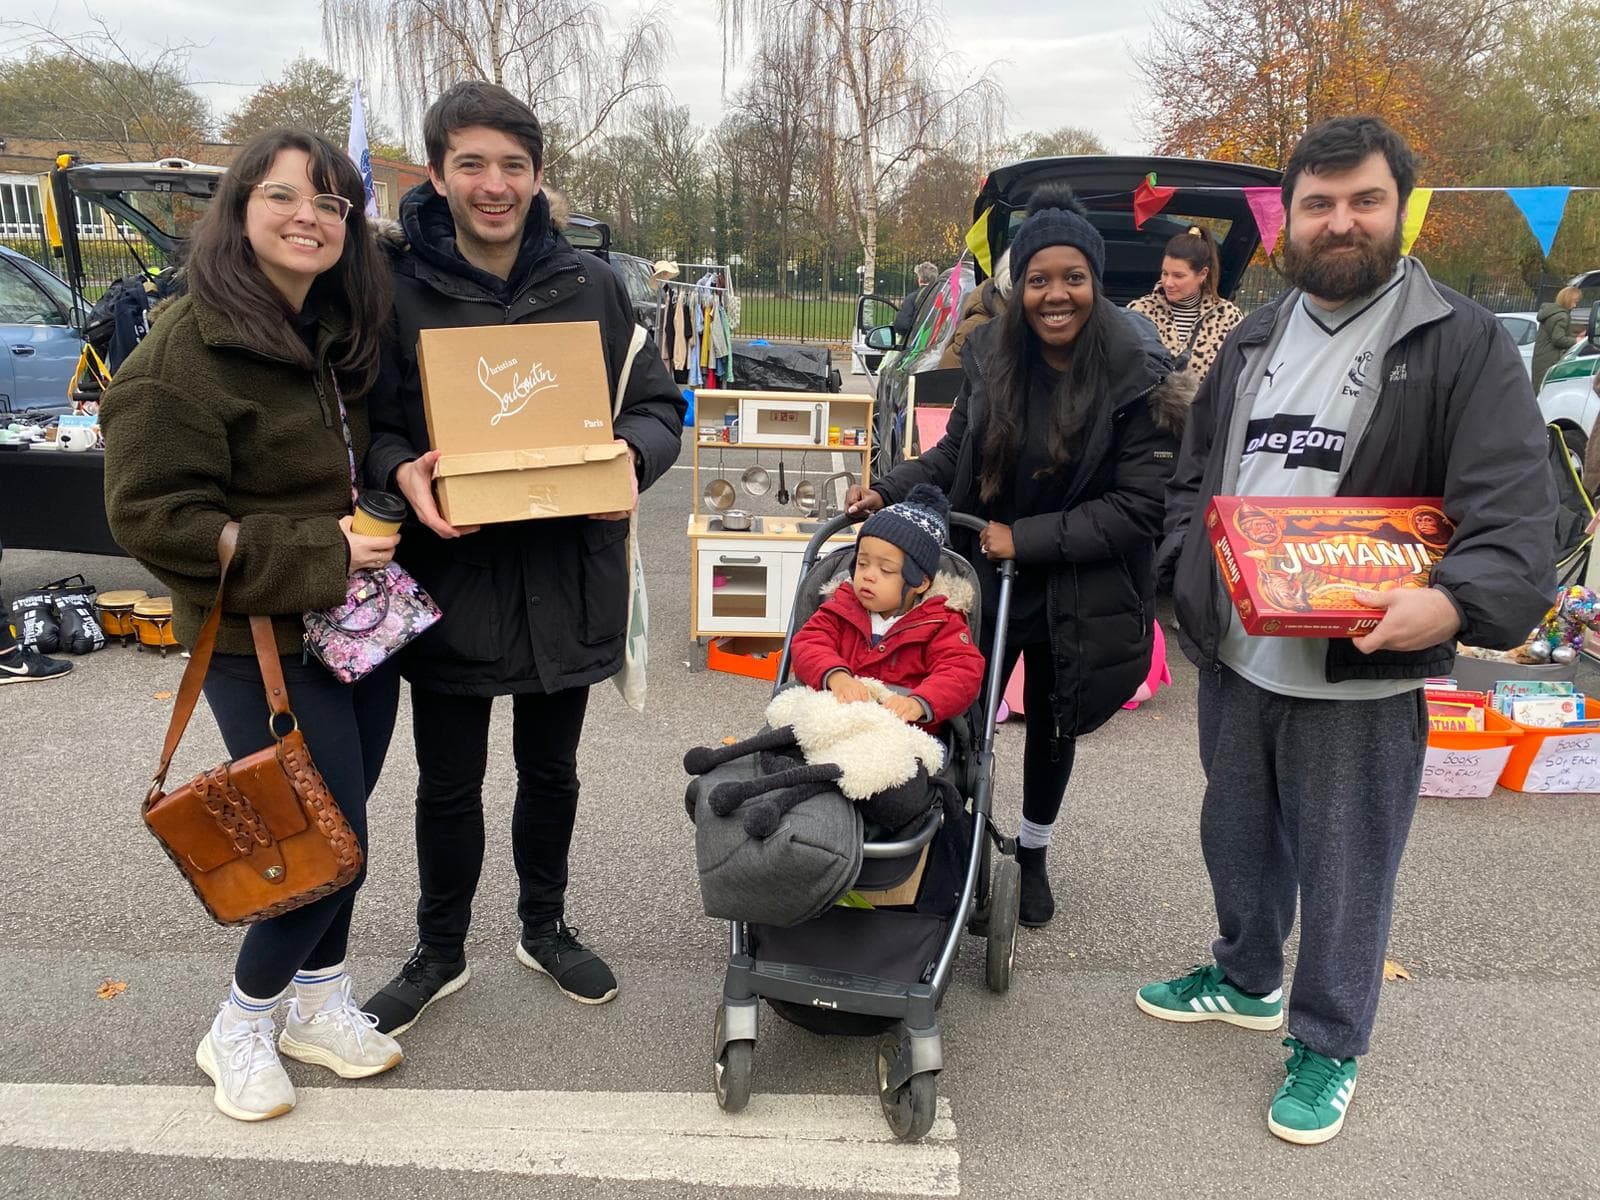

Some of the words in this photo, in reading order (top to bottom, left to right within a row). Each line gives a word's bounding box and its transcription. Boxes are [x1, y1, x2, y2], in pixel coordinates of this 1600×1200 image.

[478, 356, 518, 384] Christian
[482, 361, 559, 426] Louboutin
[584, 419, 604, 428] Paris
[1217, 536, 1240, 584] JUMANJI
[1280, 542, 1434, 574] JUMANJI
[1555, 738, 1593, 752] BOOKS
[1539, 776, 1555, 791] 5
